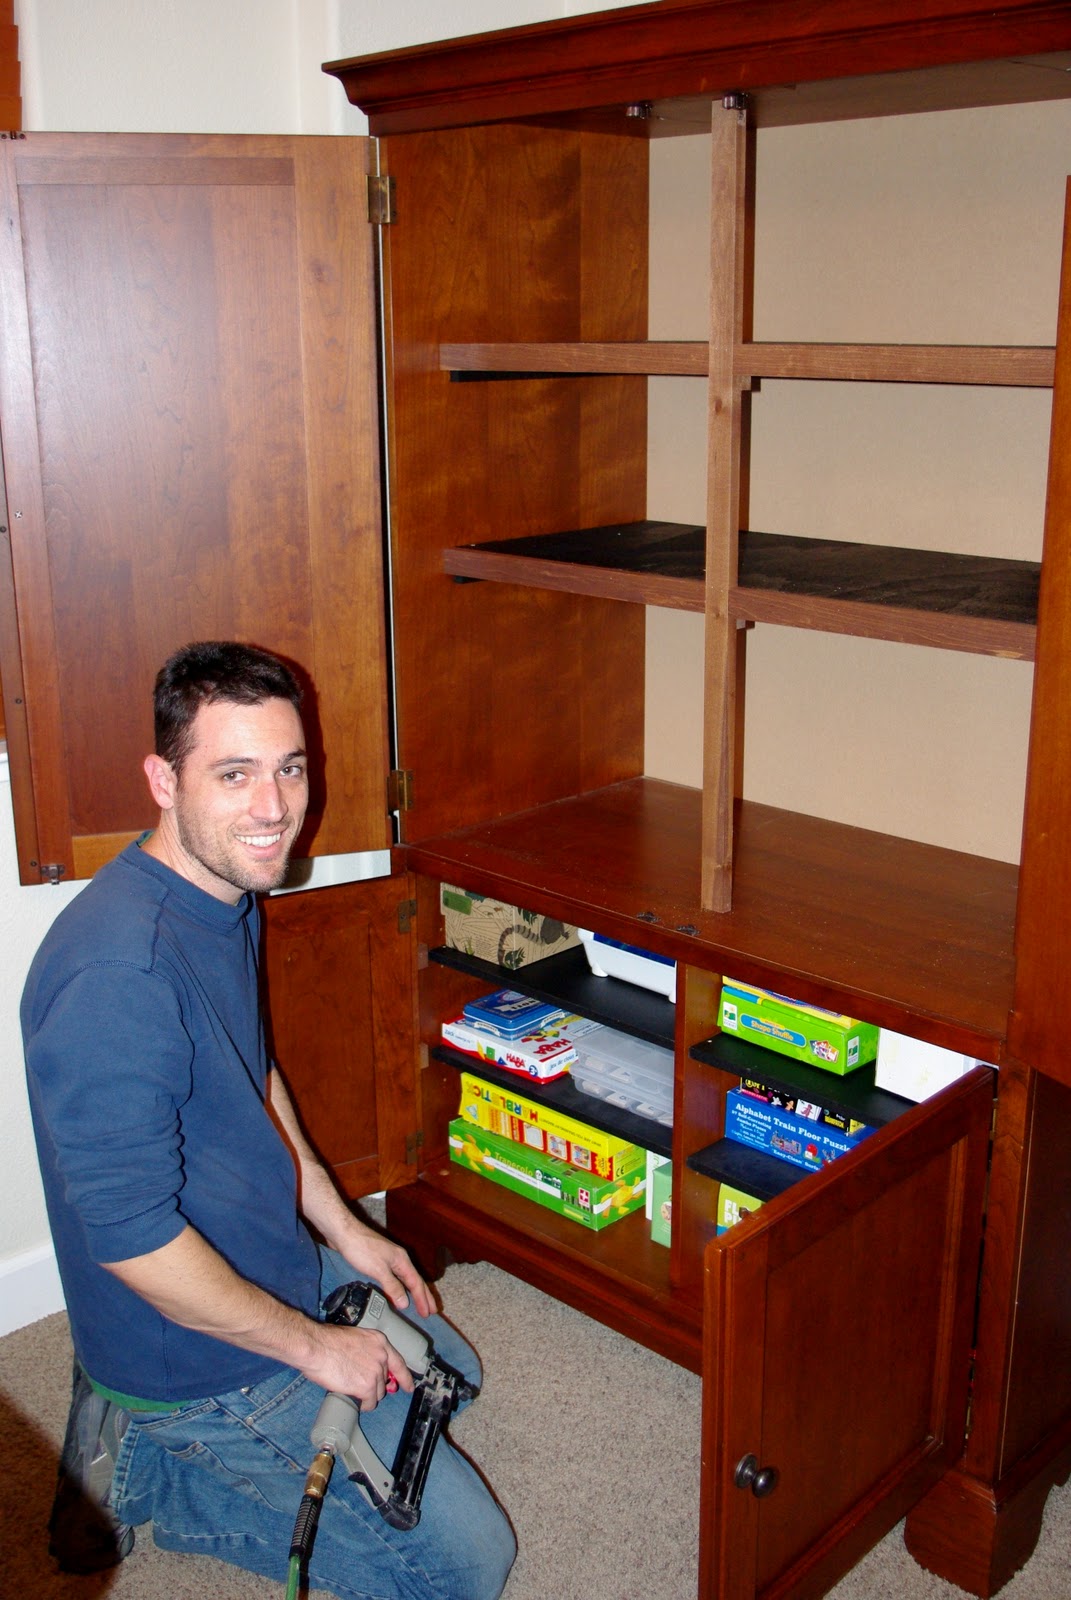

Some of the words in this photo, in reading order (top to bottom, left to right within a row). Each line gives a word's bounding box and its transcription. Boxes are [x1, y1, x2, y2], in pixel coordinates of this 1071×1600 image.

[506, 1053, 526, 1068] HABA
[736, 1103, 772, 1122] Alphabet
[773, 1117, 797, 1132] Train
[798, 1127, 821, 1141] Floor
